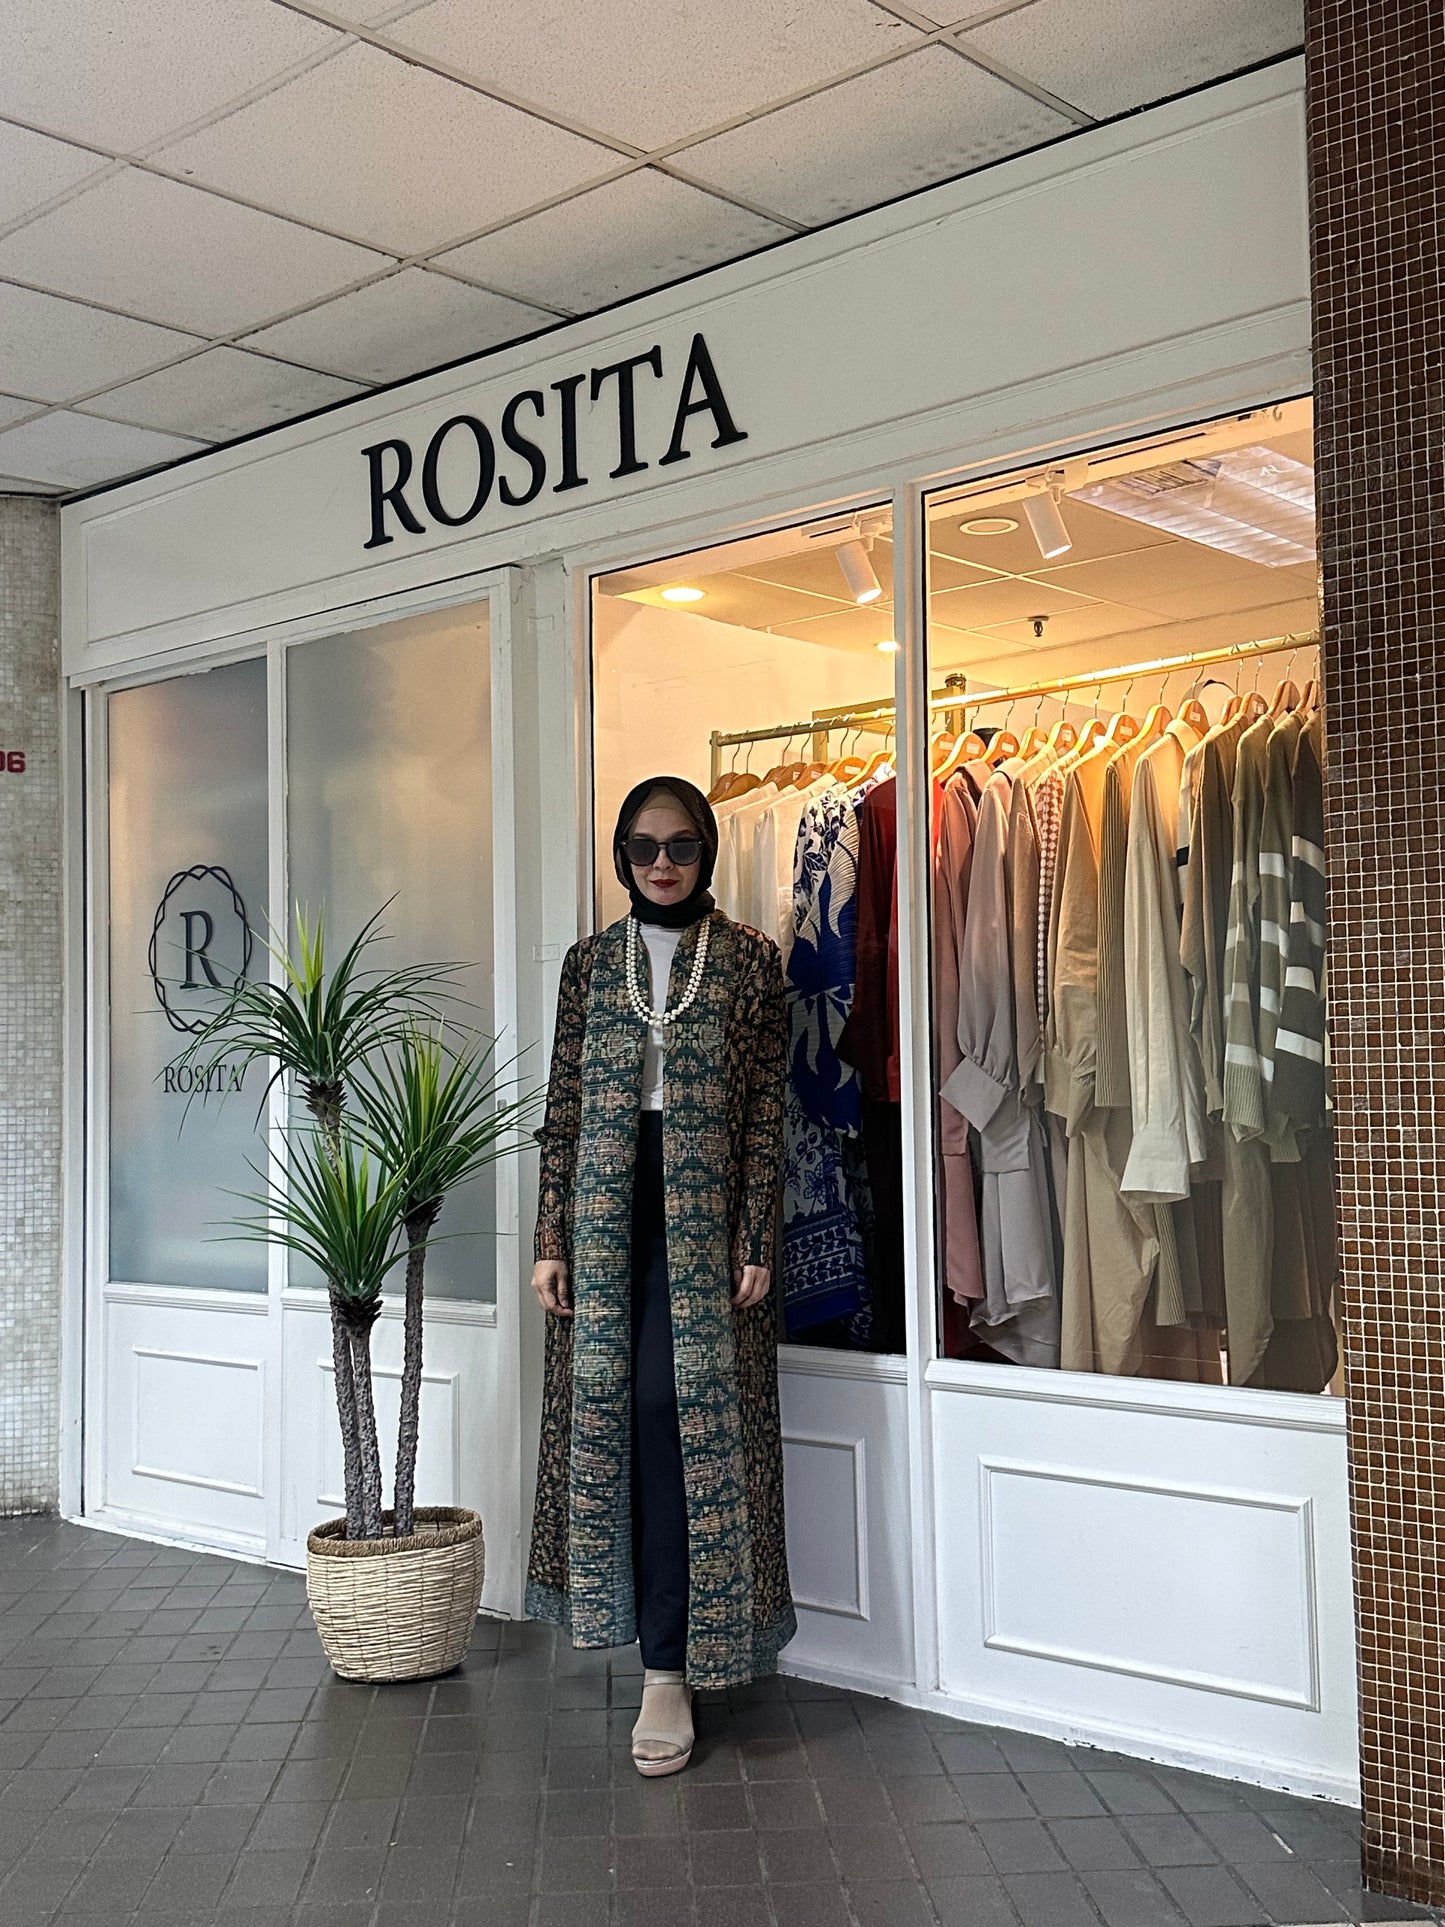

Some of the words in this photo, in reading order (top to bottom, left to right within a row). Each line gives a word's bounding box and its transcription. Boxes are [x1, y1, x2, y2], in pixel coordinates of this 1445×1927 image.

[361, 333, 748, 549] ROSITA
[180, 910, 221, 989] R
[163, 1064, 242, 1093] ROSITA
